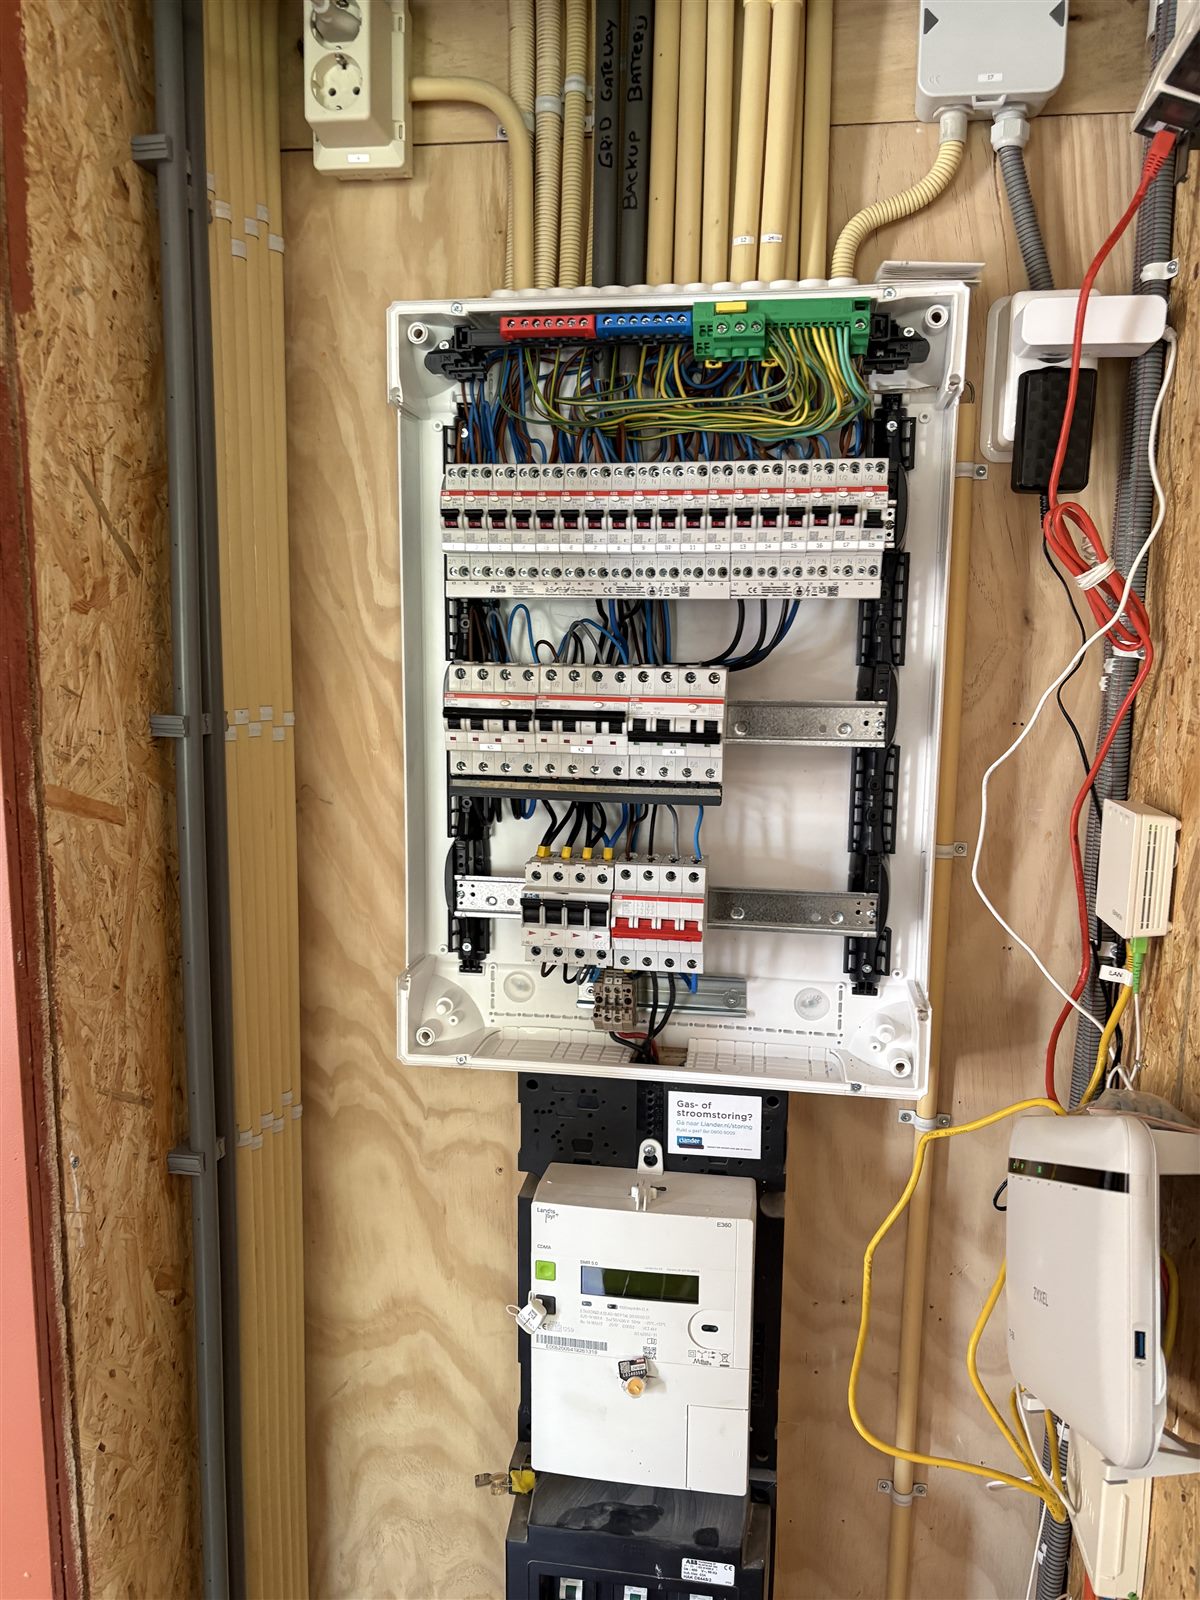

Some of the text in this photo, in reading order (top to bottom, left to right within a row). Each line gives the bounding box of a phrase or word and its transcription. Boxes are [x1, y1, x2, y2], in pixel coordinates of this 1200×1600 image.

[1108, 969, 1123, 979] LAN
[676, 1100, 712, 1109] Gas- of
[676, 1110, 753, 1122] stroomstoring?
[1032, 1286, 1049, 1307] ZYXEL
